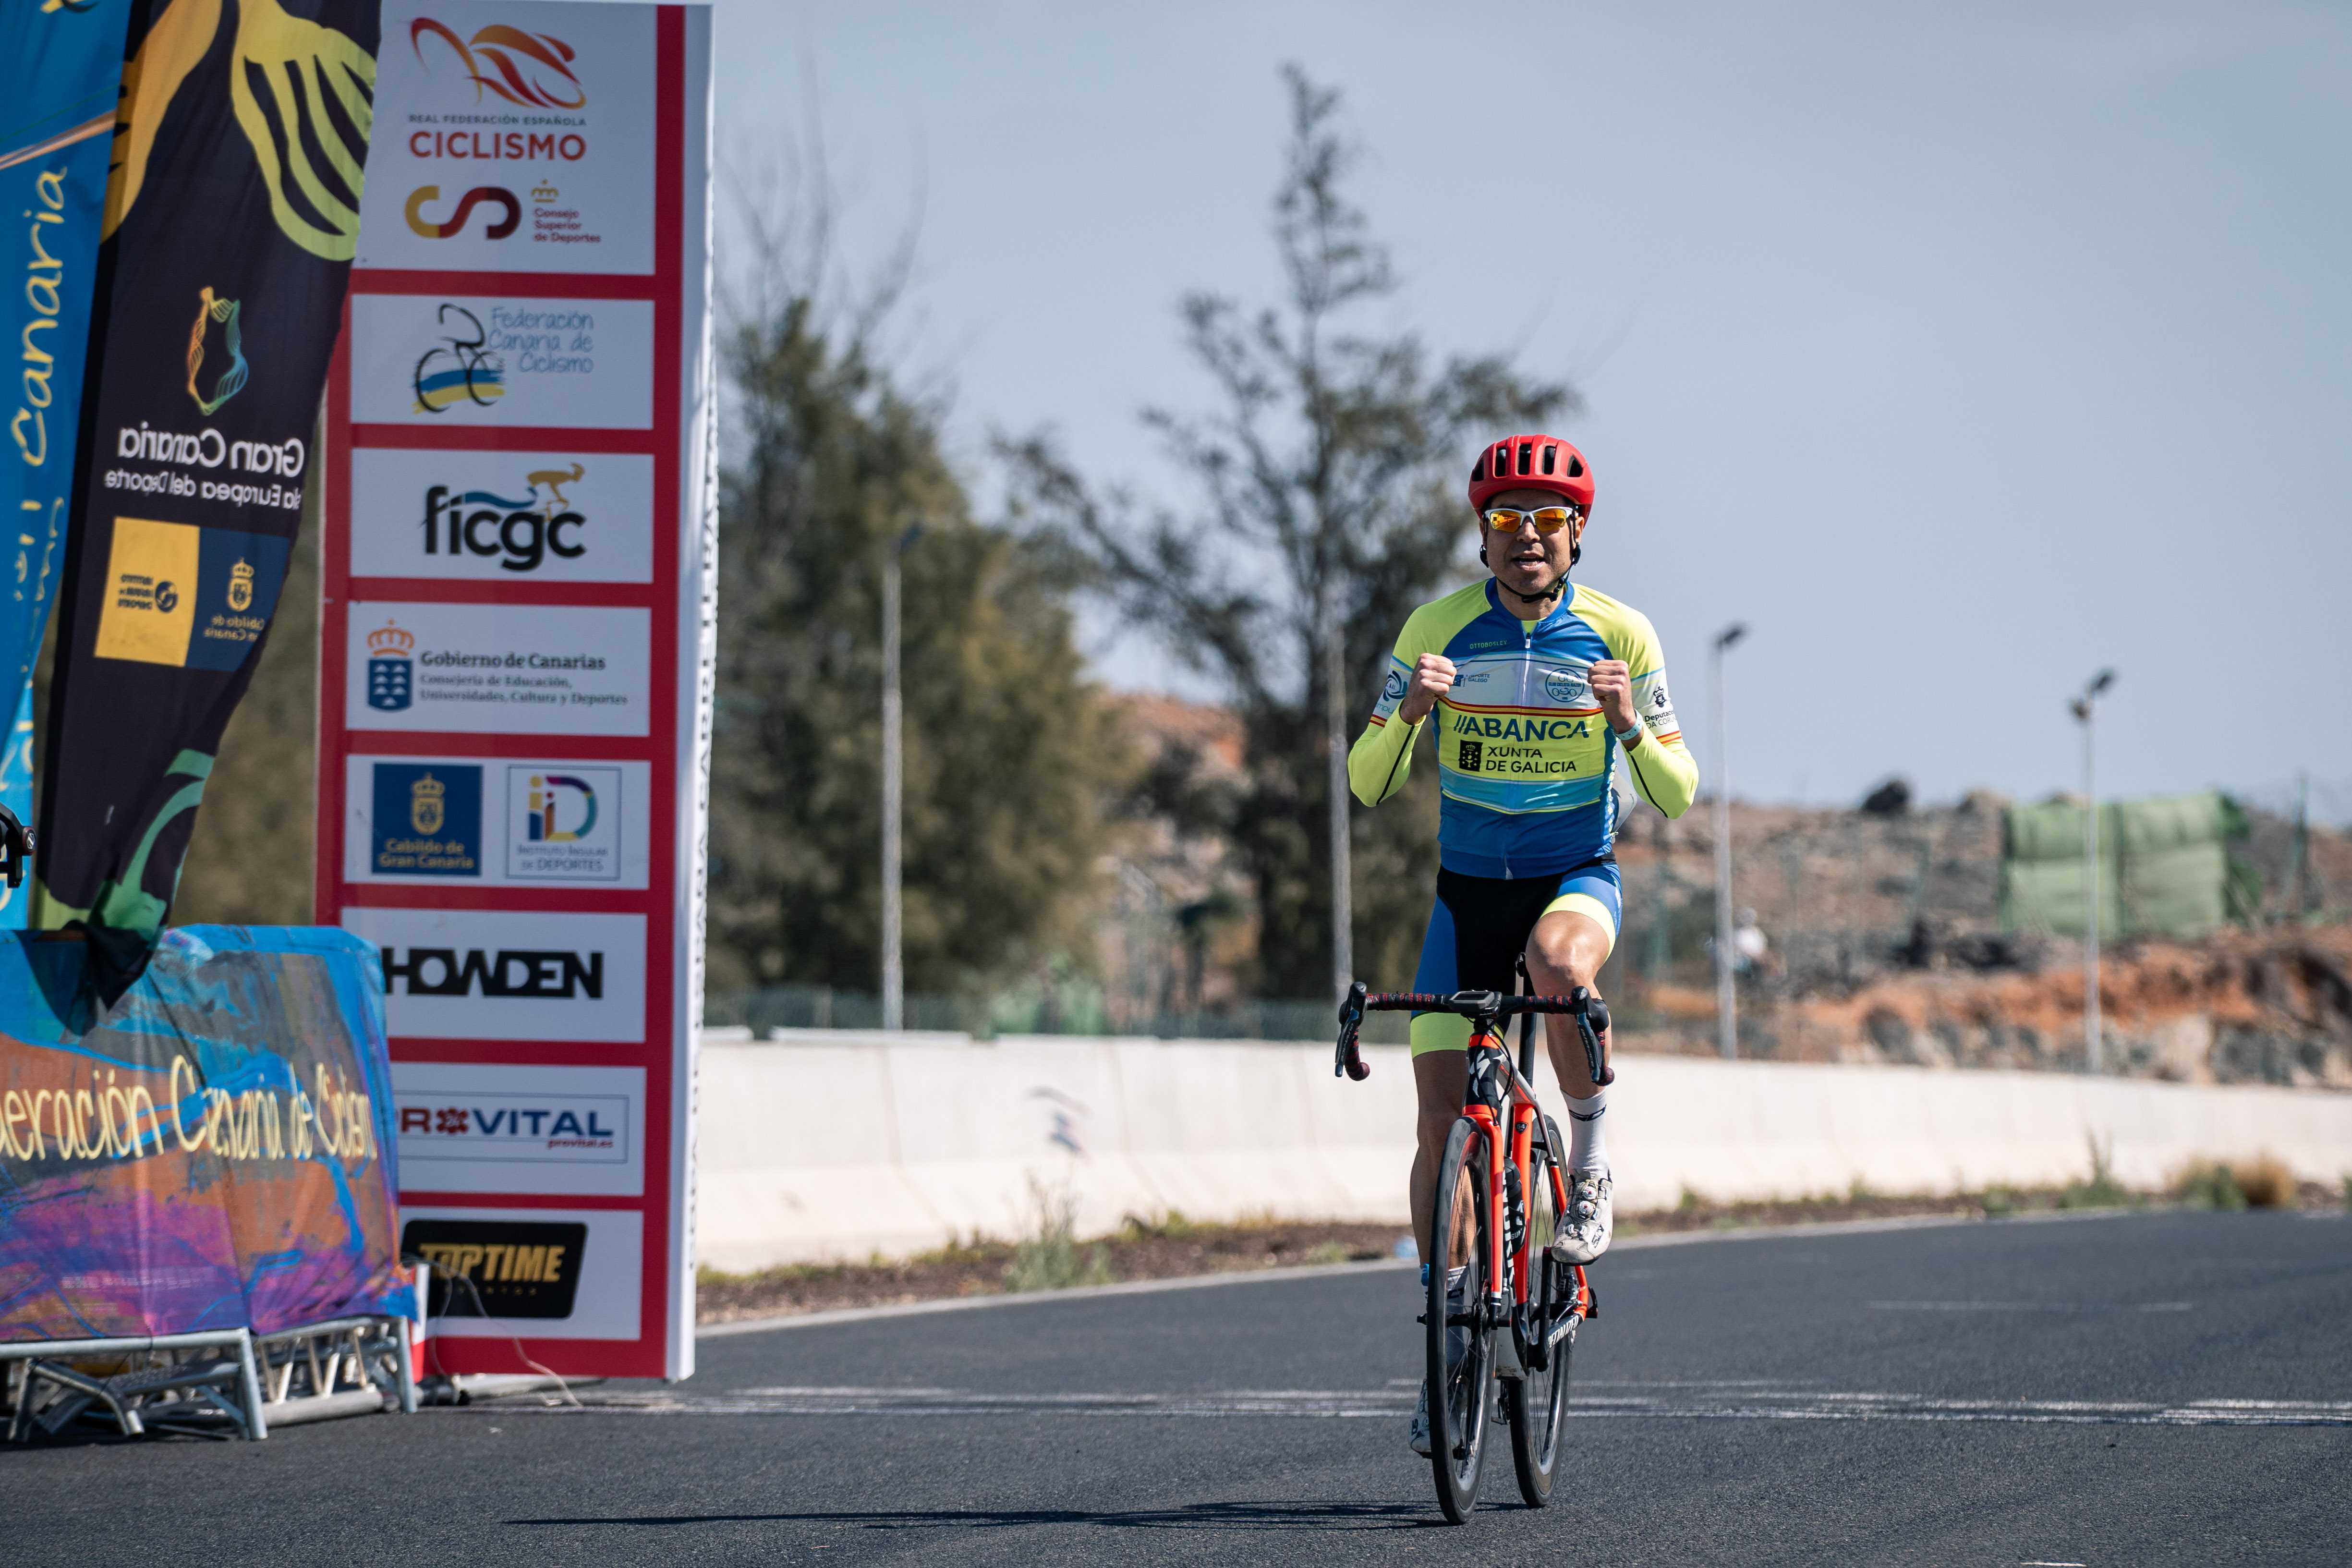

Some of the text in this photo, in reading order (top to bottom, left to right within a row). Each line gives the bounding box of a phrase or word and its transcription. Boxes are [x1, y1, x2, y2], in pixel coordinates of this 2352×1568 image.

[409, 113, 586, 126] REAL FEDERACIÓN ESPAÑOLA
[409, 131, 586, 160] CICLISMO
[534, 208, 579, 220] Consejo
[534, 219, 582, 232] Superior
[534, 232, 601, 244] de Deportes
[492, 306, 594, 331] Federación
[488, 331, 594, 352] Canaria de
[518, 352, 594, 374] Ciclismo
[424, 485, 587, 572] ficgc
[420, 650, 606, 670] Gobierno de Canarias
[486, 675, 501, 687] de
[511, 691, 556, 703] Cultura
[560, 695, 567, 706] y
[571, 693, 628, 706] Deportes
[1487, 746, 1542, 758] XUNTA
[1485, 760, 1576, 773] DE GALICIA
[386, 838, 464, 853] Cabildo de
[379, 852, 474, 869] Gran Canaria
[382, 947, 604, 999] HOWDEN
[170, 1055, 286, 1160] Cnaria
[395, 1106, 613, 1137] ROVITAL
[547, 1138, 613, 1150] provital.es
[419, 1242, 566, 1282] TOPTIME
